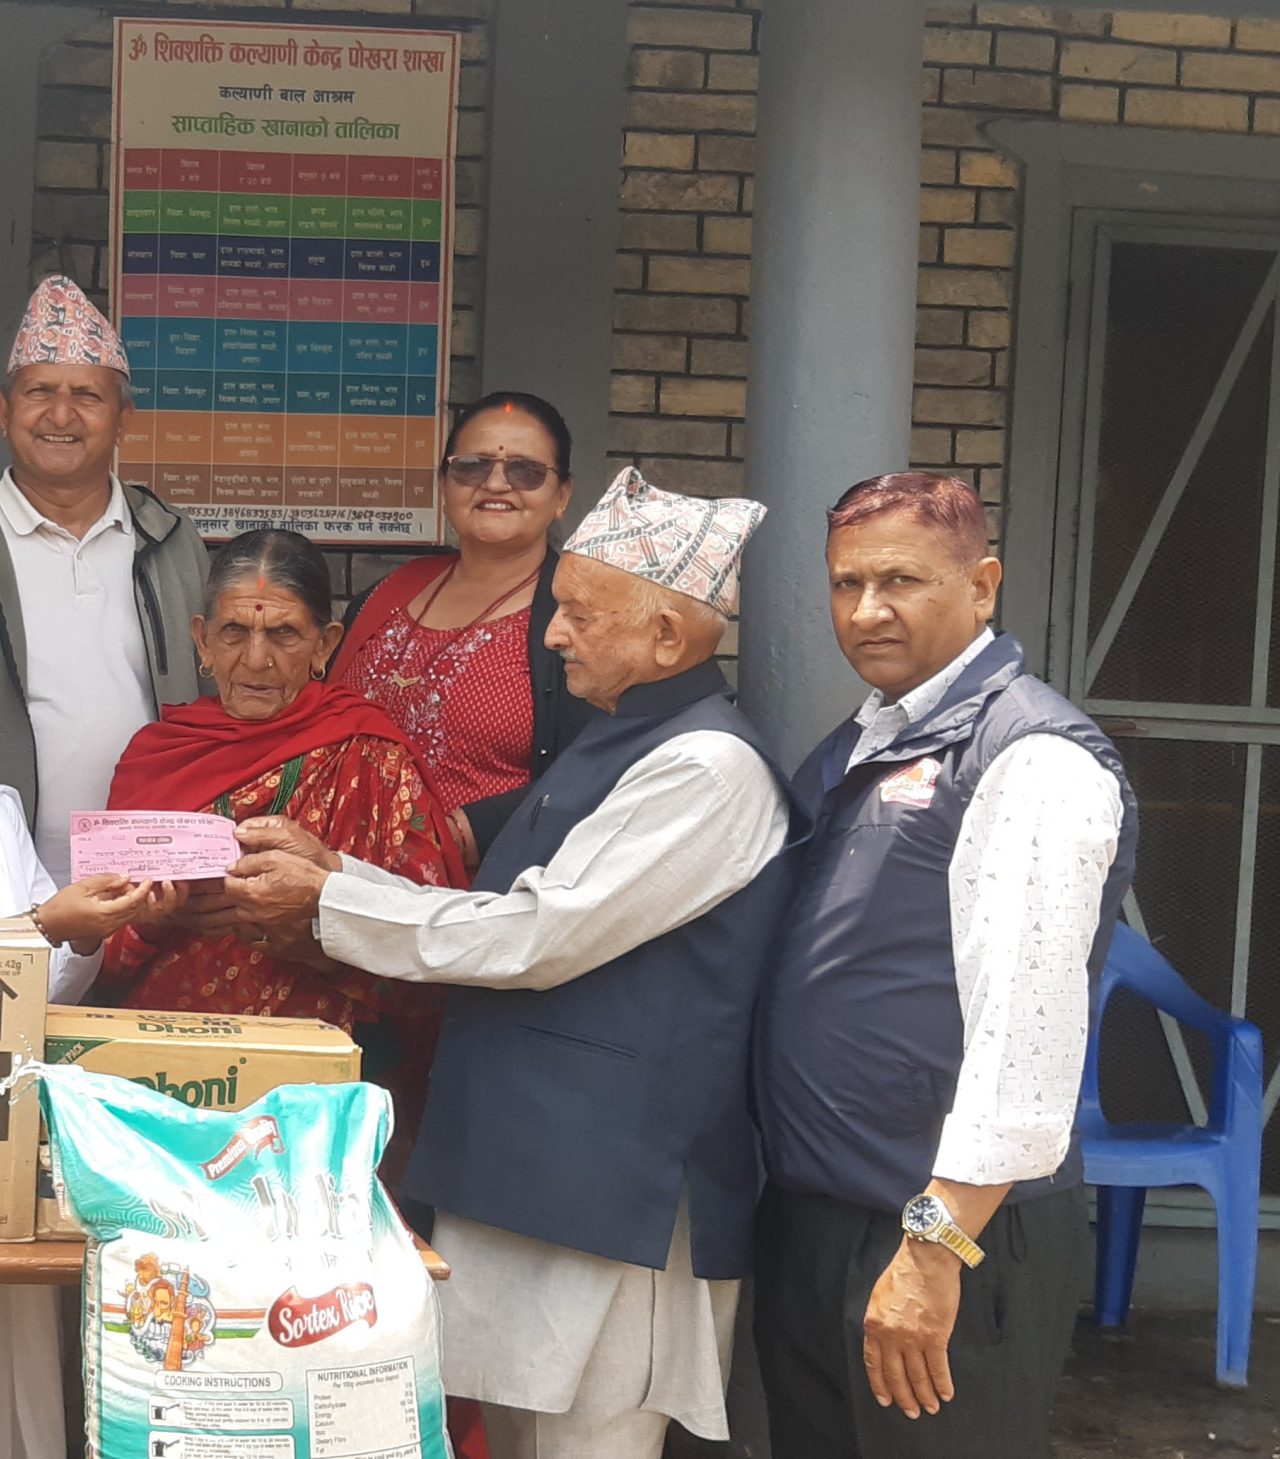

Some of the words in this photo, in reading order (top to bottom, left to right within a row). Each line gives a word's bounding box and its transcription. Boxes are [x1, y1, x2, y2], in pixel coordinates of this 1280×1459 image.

[129, 34, 147, 60] ॐ
[154, 32, 225, 63] शिवशक्ति
[229, 38, 298, 66] कल्याणी
[303, 39, 343, 70] केन्द्र
[348, 40, 398, 70] पोखरा
[402, 48, 446, 72] शाखा
[219, 84, 273, 100] कल्याणी
[280, 90, 306, 103] बाल
[313, 90, 355, 104] आश्रम
[171, 112, 256, 136] साप्ताहिक
[262, 116, 329, 138] खानाको
[334, 118, 400, 140] तालिका
[235, 518, 274, 530] खानाको
[280, 516, 318, 532] तालिका
[324, 521, 353, 534] फरक
[5, 960, 22, 970] 42g
[138, 1022, 241, 1034] Dhoni
[278, 1304, 339, 1344] Sortex
[336, 1288, 374, 1322] Rice
[164, 1374, 202, 1386] COOKING
[204, 1376, 271, 1388] INSTRUCTIONS
[318, 1370, 368, 1382] NUTRITIONAL
[369, 1360, 408, 1376] INFORMATION
